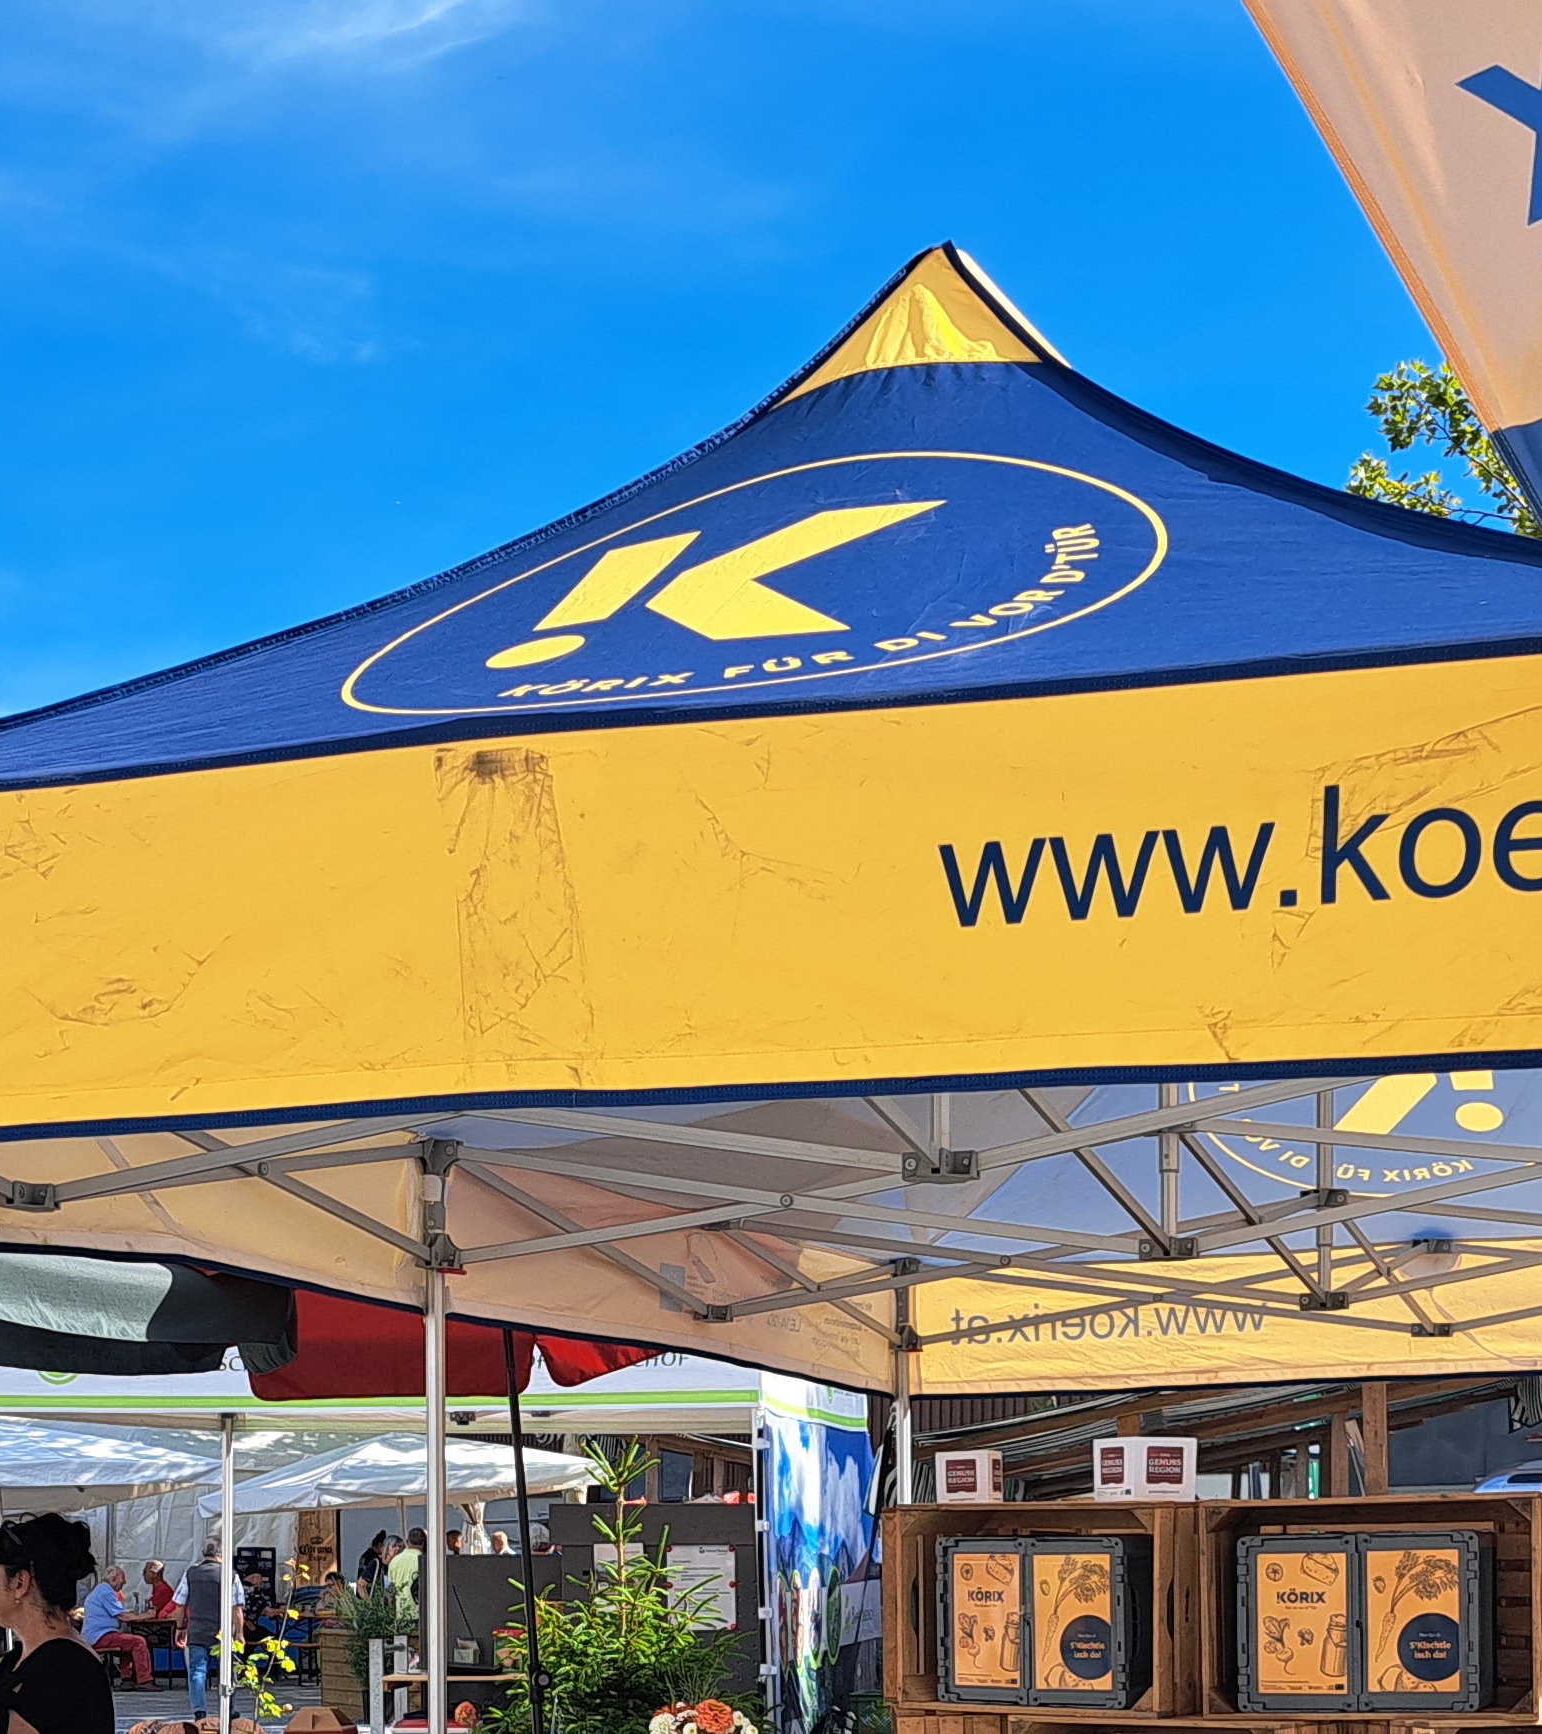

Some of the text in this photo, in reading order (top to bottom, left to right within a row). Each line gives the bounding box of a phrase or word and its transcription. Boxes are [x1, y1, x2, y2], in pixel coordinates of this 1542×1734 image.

[497, 671, 694, 698] KÖRIX
[722, 649, 856, 679] FÜR
[873, 630, 948, 653] DI
[949, 588, 1065, 629] VOR
